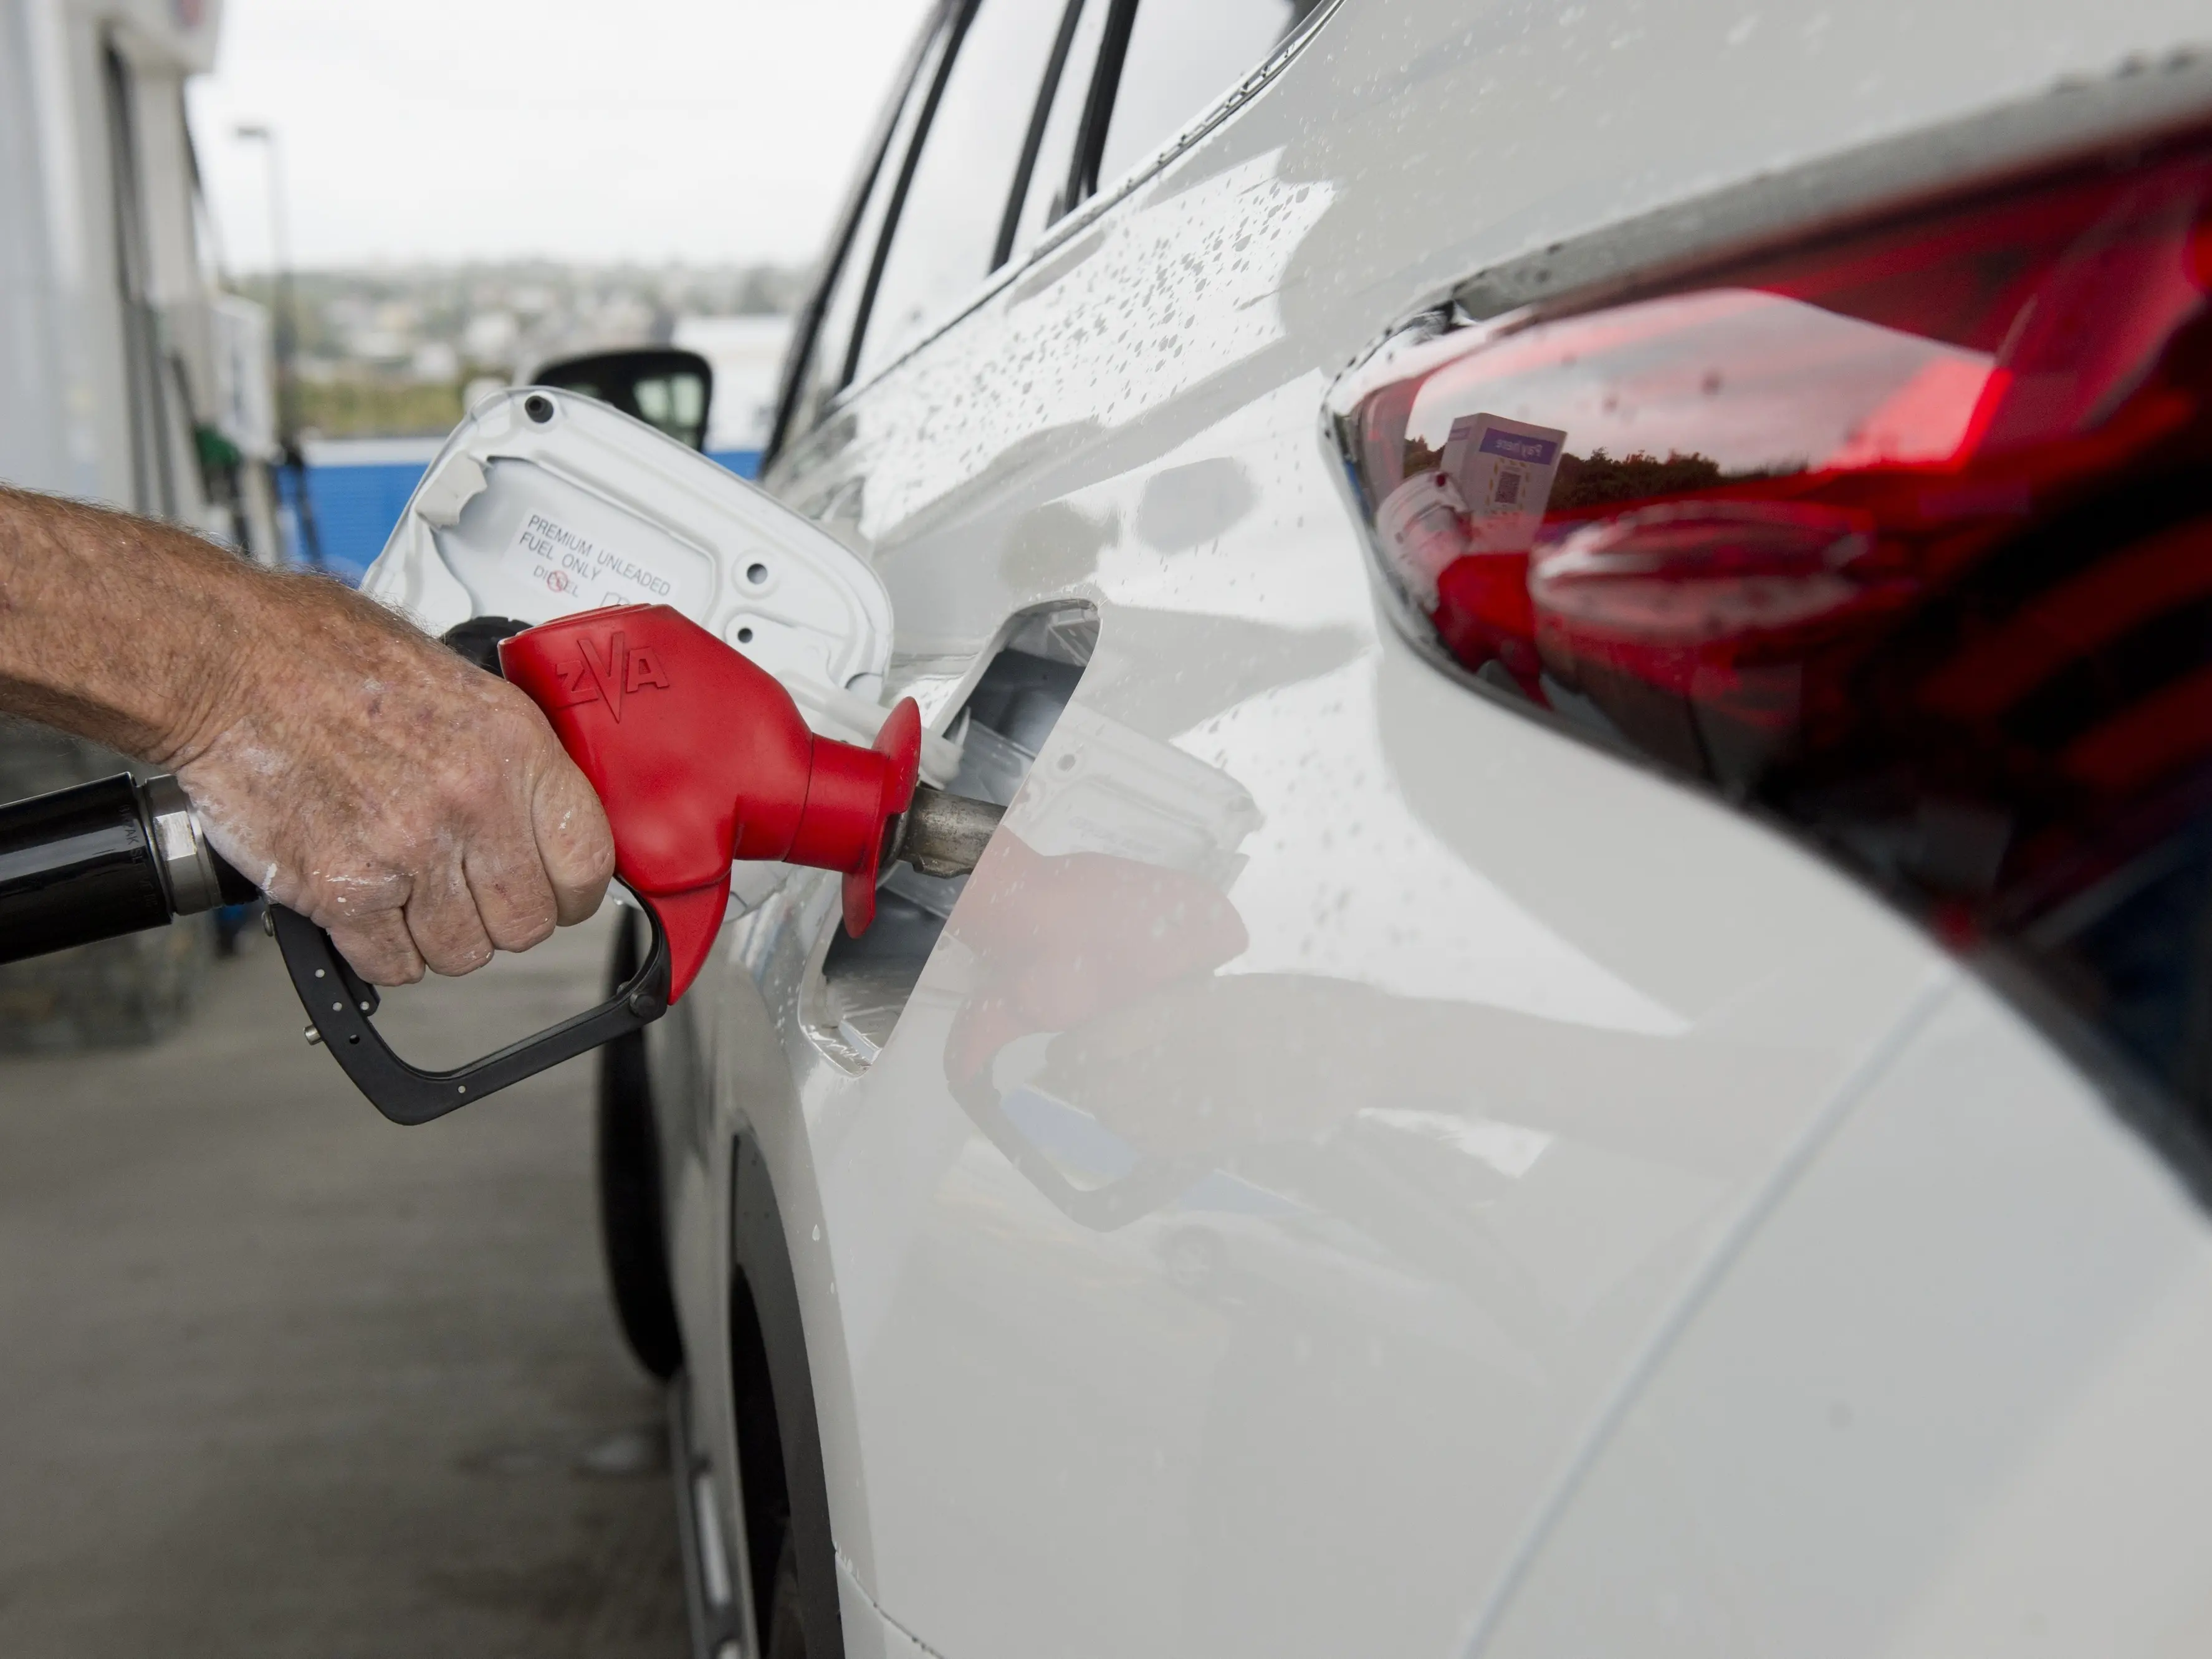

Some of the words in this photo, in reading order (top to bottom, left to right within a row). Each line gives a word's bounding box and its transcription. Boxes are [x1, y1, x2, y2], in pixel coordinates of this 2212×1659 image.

[519, 531, 553, 560] FUEL
[562, 553, 602, 581] ONLY
[528, 514, 593, 557] PREMIUM
[597, 550, 671, 596] UNLEADED
